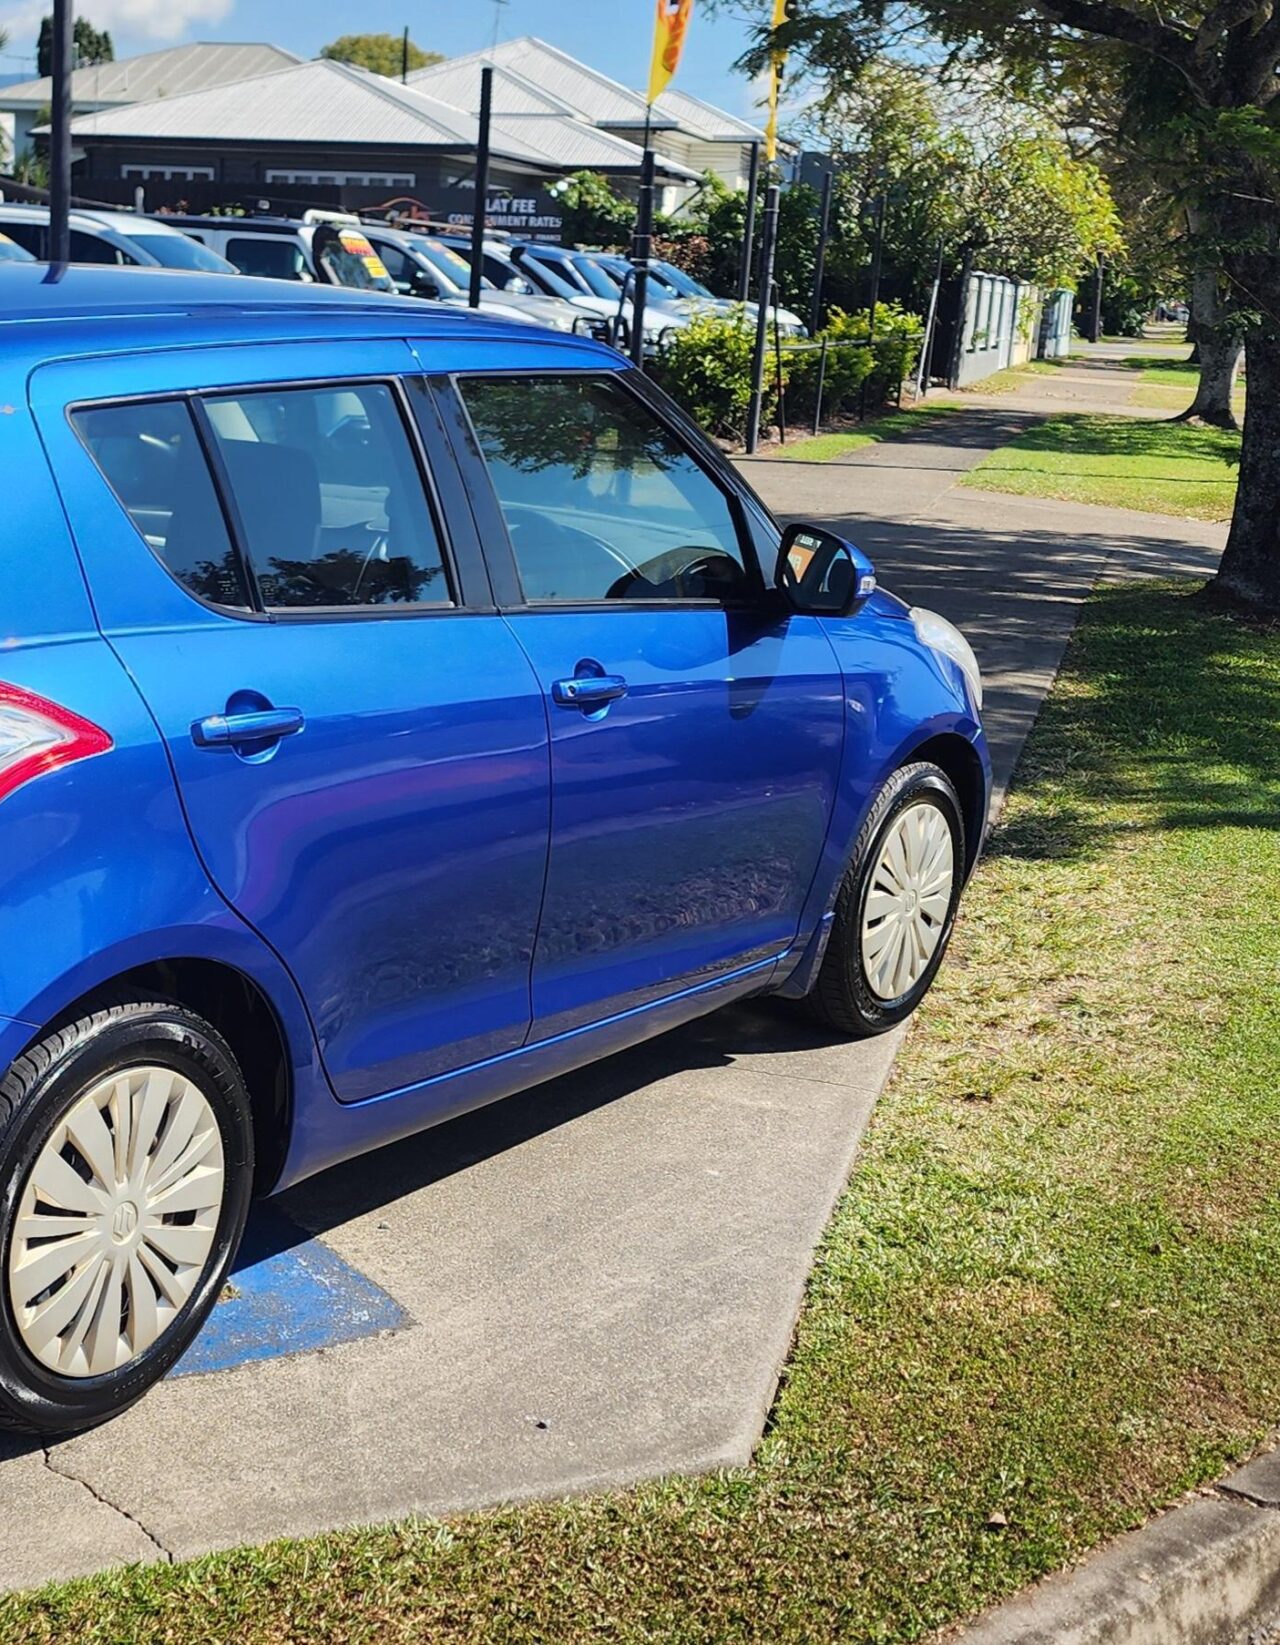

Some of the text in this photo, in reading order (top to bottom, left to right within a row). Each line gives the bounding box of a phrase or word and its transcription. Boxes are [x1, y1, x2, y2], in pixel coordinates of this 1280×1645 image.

[485, 199, 536, 213] LAT FEE
[529, 216, 562, 228] RATES
